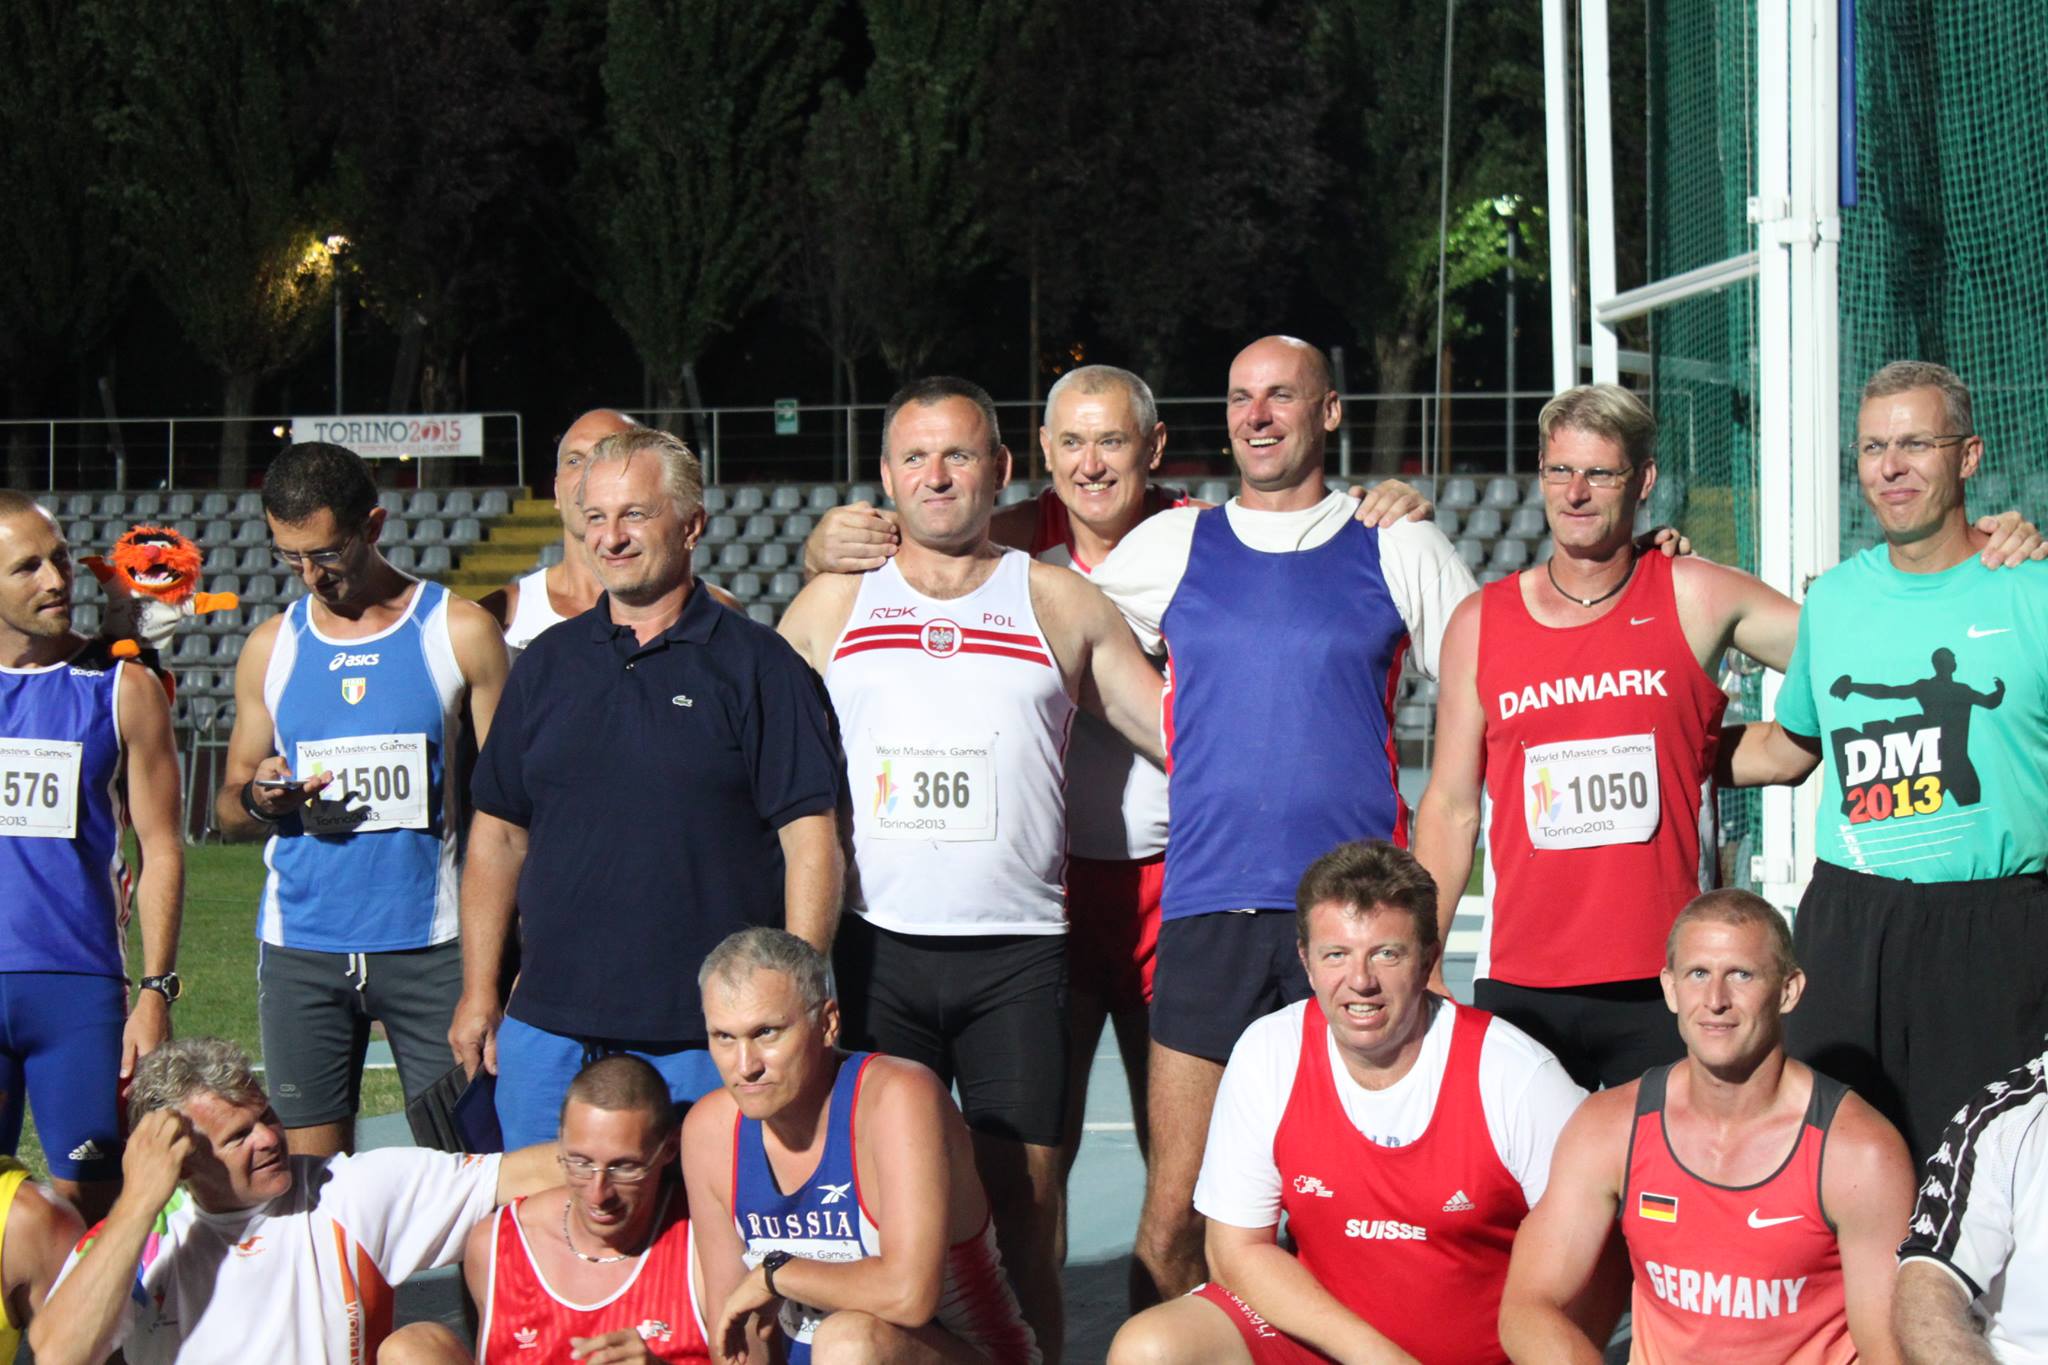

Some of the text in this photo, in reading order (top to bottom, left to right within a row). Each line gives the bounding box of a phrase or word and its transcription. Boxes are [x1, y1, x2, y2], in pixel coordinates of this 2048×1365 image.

[983, 613, 1016, 627] POL
[1499, 669, 1668, 720] DANMARK
[34, 748, 72, 758] Games
[304, 741, 418, 758] World Masters Games
[875, 746, 988, 756] World Masters Games
[1528, 744, 1652, 764] World Masters Games
[1844, 727, 1942, 787] DM
[5, 771, 59, 808] 576
[337, 764, 410, 802] 1500
[913, 771, 970, 808] 366
[1568, 771, 1648, 814] 1050
[1847, 775, 1943, 825] 2013
[0, 815, 27, 826] 2013
[879, 817, 946, 830] Torino2013
[1540, 820, 1615, 838] Torino2013
[1442, 1202, 1475, 1212] adidas
[747, 1210, 854, 1239] RUSSIA
[1344, 1219, 1427, 1241] SUISSE
[817, 1250, 853, 1260] Games
[1645, 1260, 1808, 1320] GERMANY
